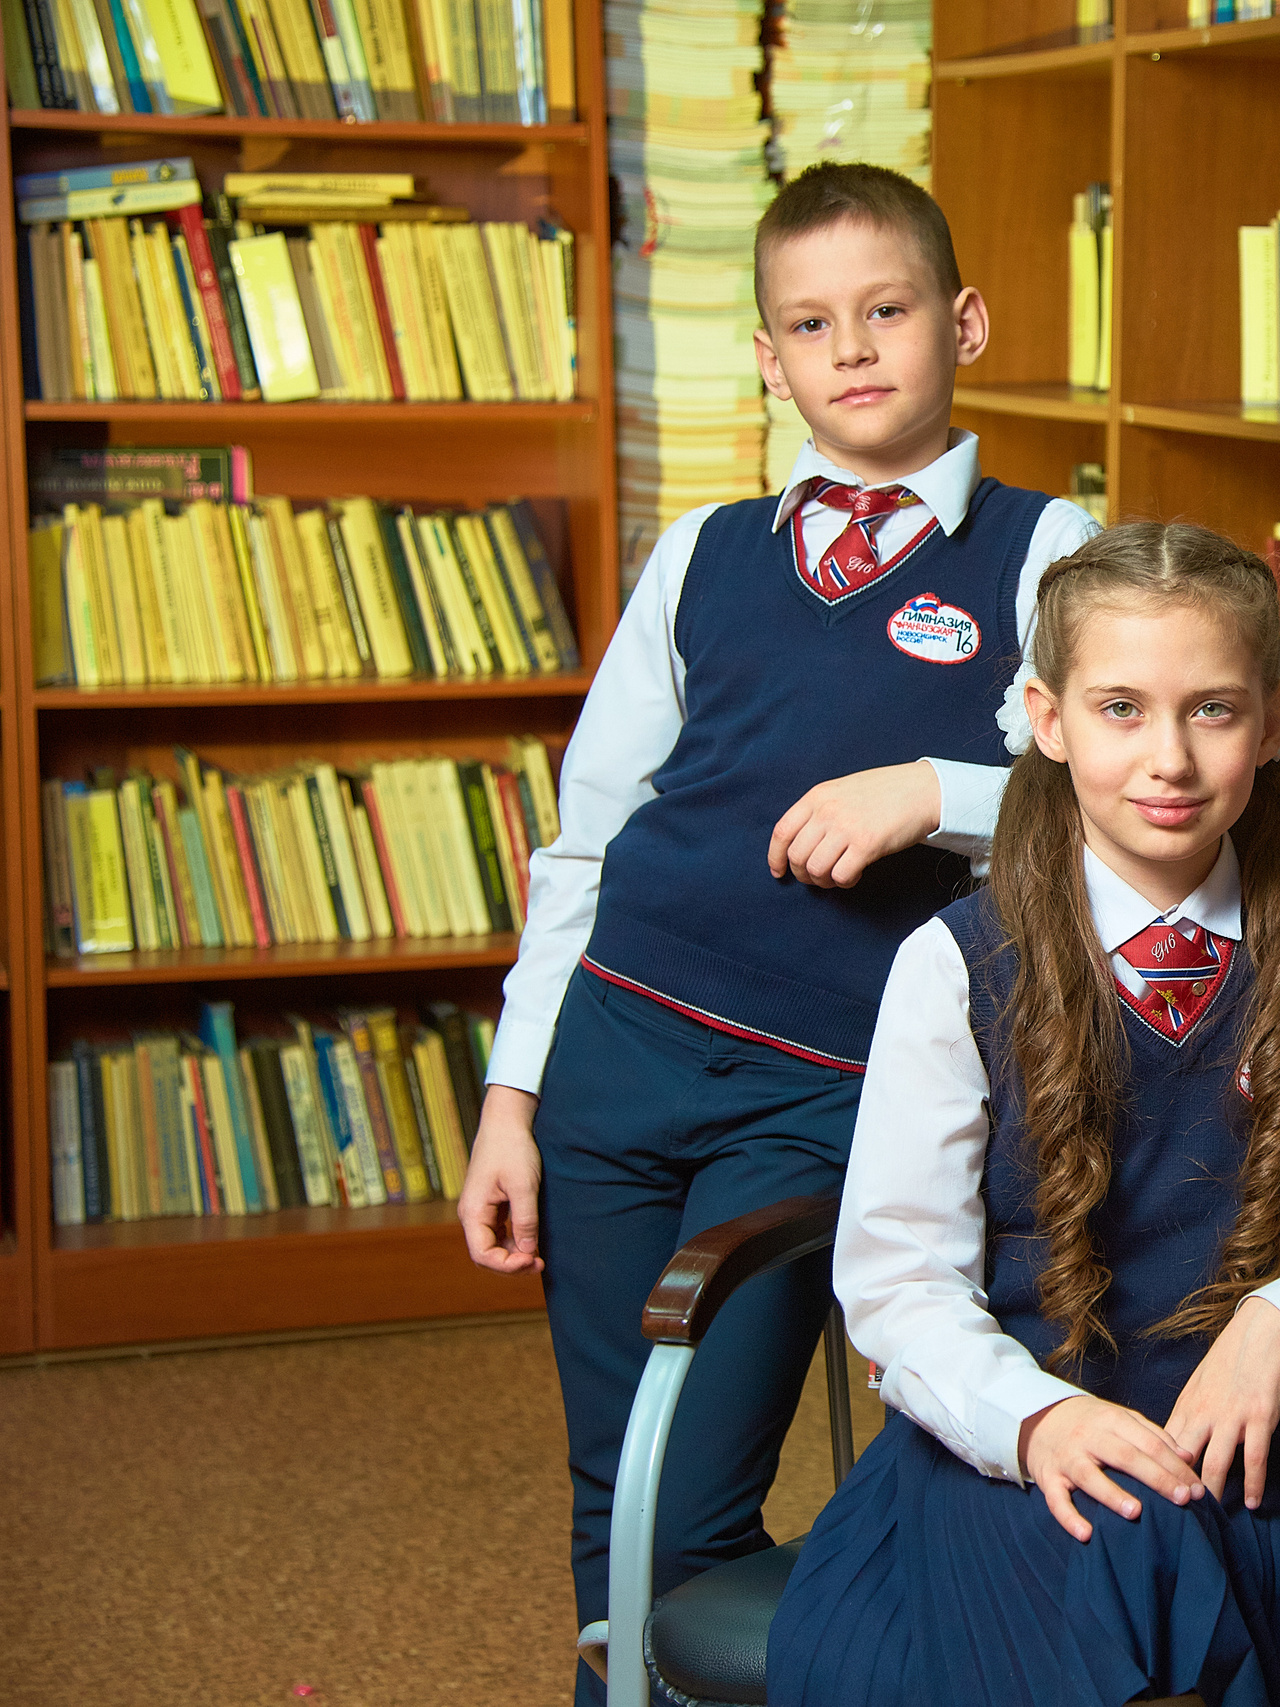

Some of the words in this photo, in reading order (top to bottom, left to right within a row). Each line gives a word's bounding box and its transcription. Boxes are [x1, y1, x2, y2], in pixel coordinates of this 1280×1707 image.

[902, 611, 972, 632] ГИМНАЗИЯ
[897, 630, 948, 643] НОВОСИБИРСК
[956, 630, 973, 654] 16
[1151, 932, 1176, 963] G16
